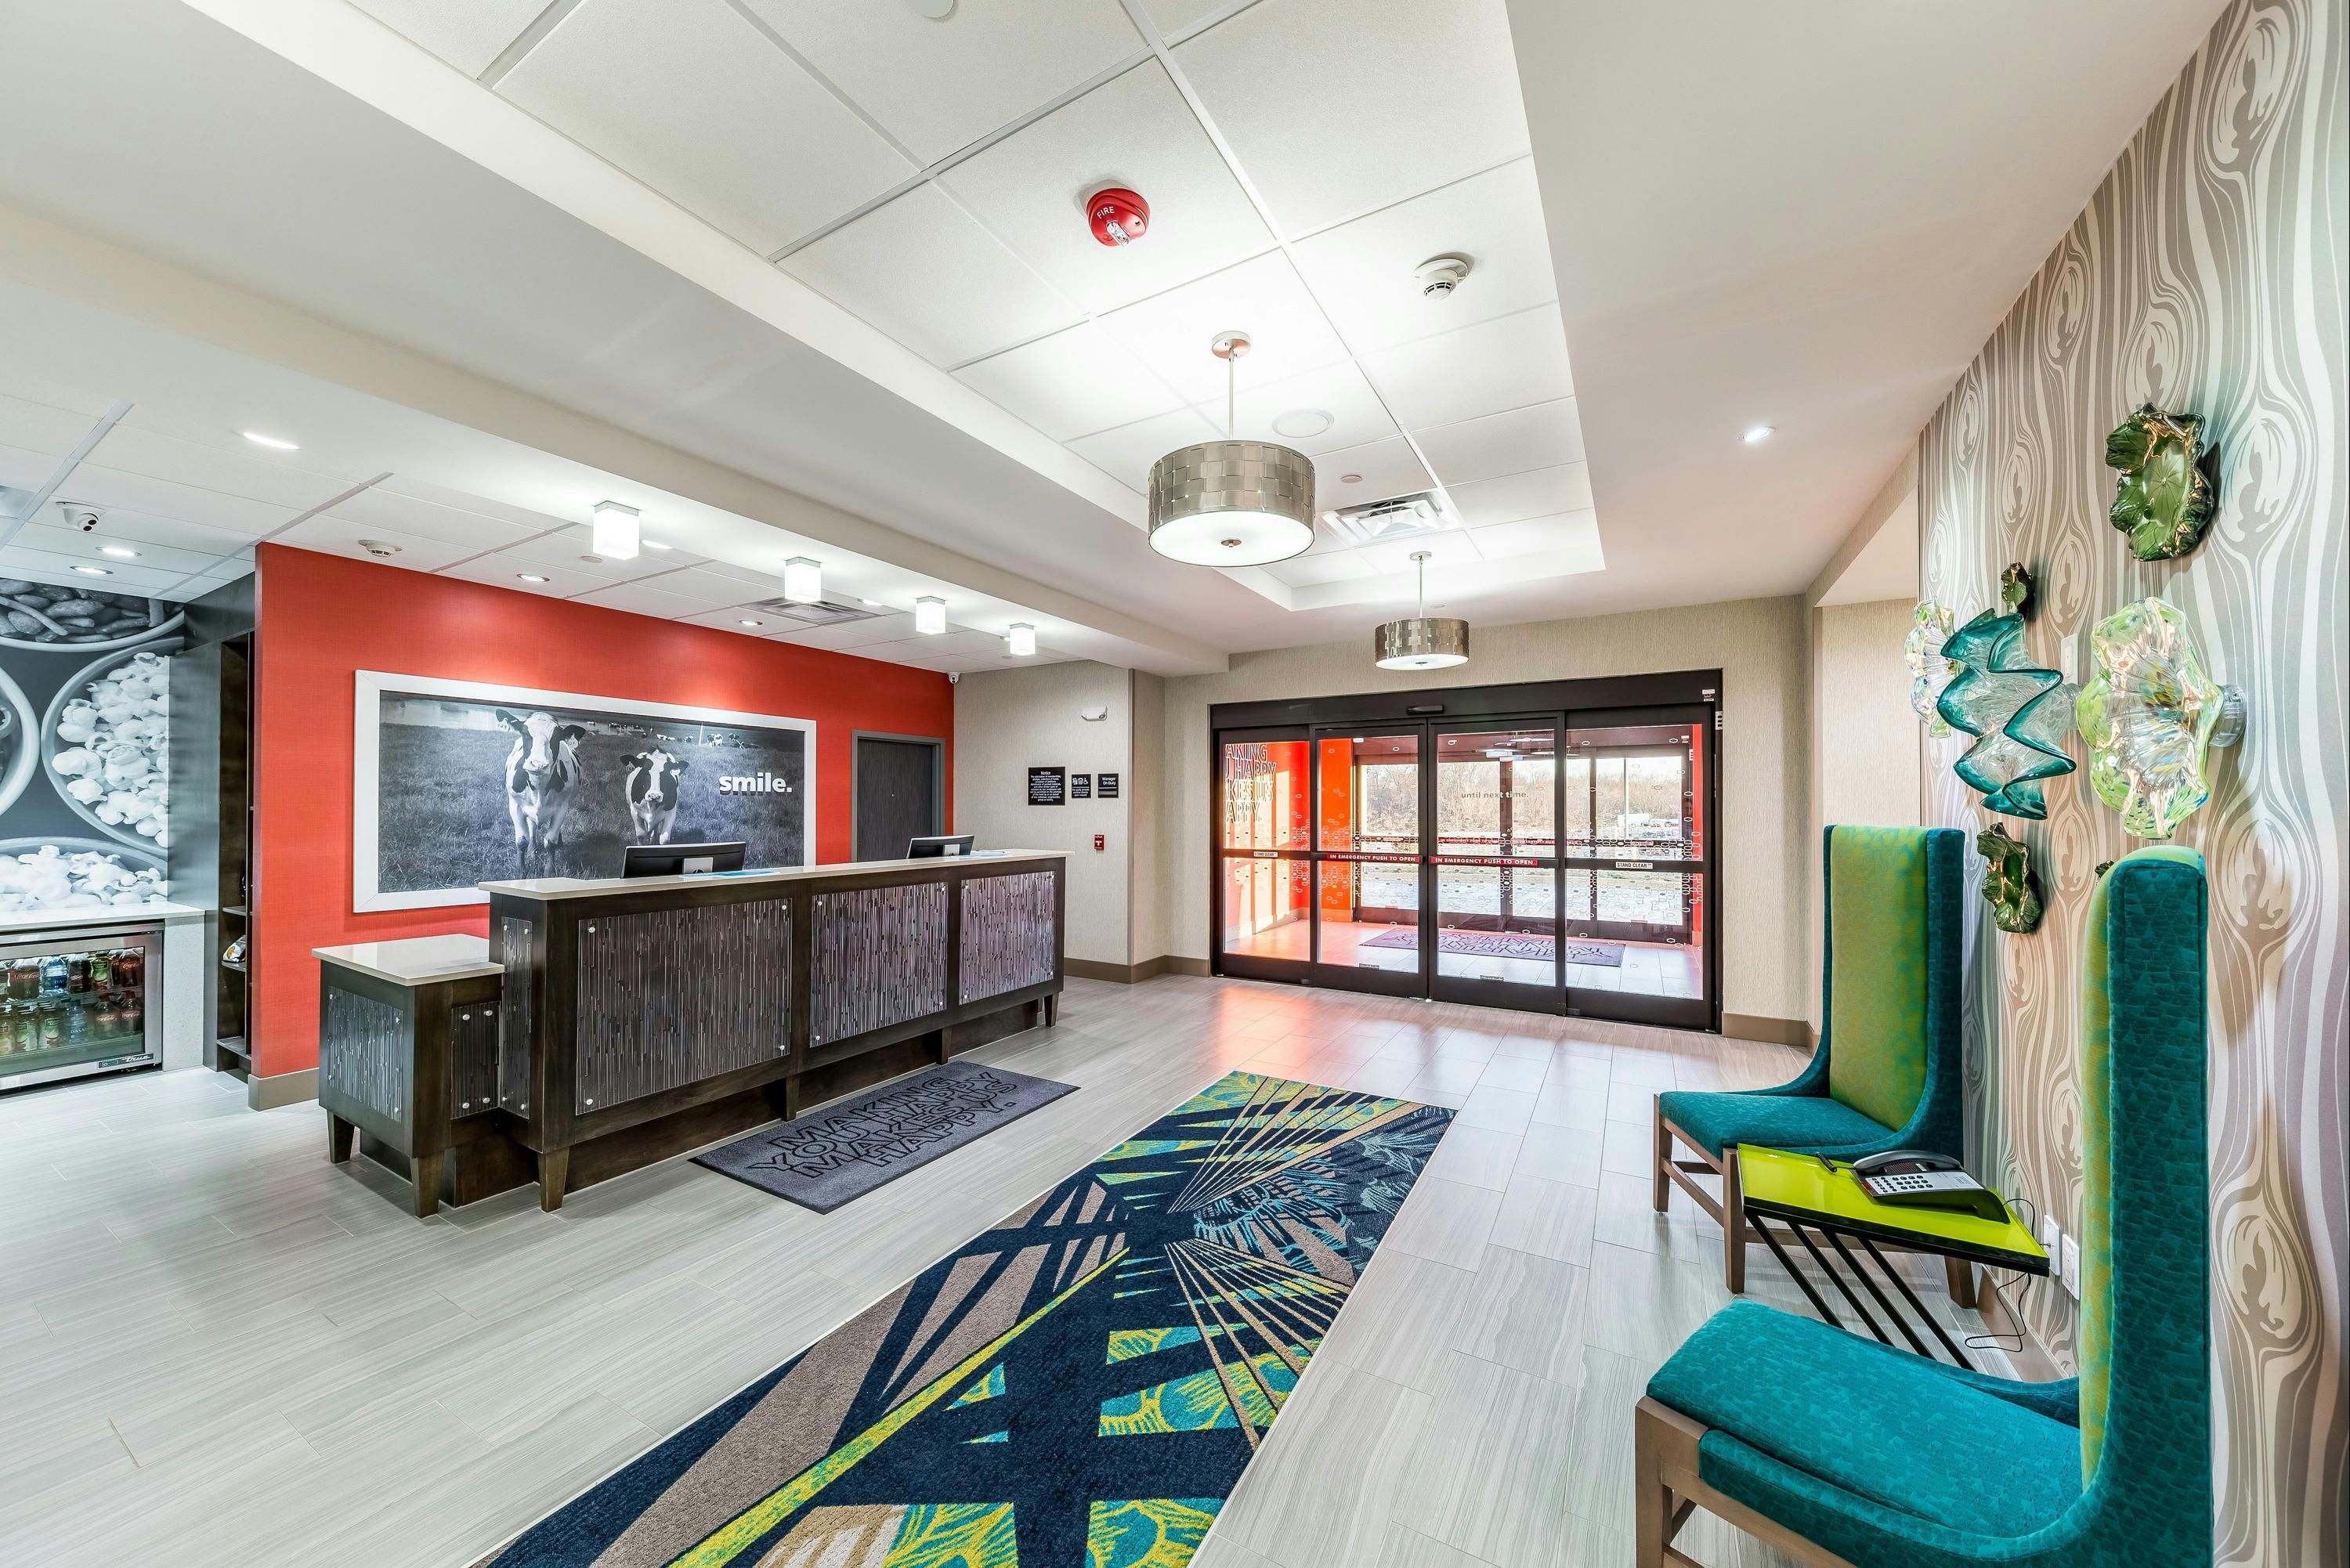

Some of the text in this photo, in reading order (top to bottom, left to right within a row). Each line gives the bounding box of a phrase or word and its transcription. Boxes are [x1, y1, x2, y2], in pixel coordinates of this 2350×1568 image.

[1097, 206, 1115, 219] FIRE
[1225, 743, 1267, 762] AKING
[719, 771, 792, 796] smile.
[1225, 801, 1264, 823] APPY.
[745, 1071, 1001, 1171] YOU HAPPY
[767, 1078, 962, 1151] MAKING
[790, 1082, 1018, 1178] MAKES US
[855, 1099, 1016, 1167] HAPPY.
